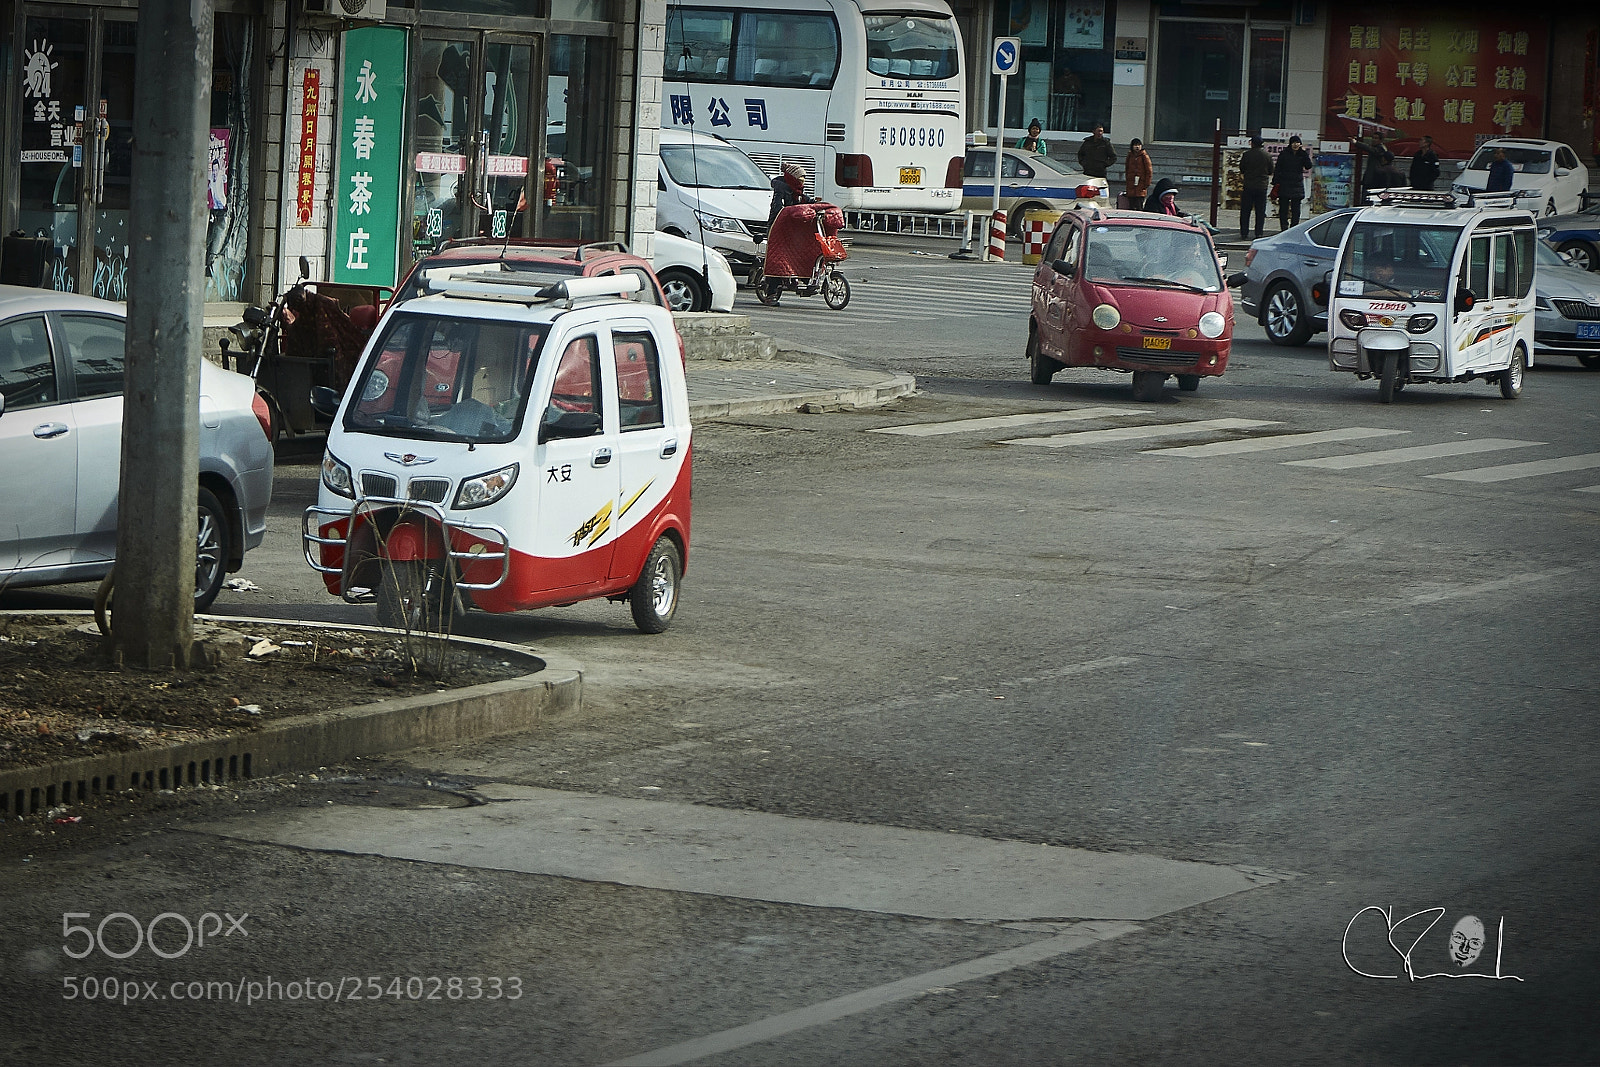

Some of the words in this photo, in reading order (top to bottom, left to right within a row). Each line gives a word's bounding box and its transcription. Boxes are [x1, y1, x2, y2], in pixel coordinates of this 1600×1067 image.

[1350, 24, 1380, 49] 富强
[1399, 27, 1430, 50] 民主
[1448, 30, 1479, 53] 文明
[1497, 31, 1529, 55] 和谐
[1348, 60, 1377, 84] 自由
[1396, 62, 1429, 87] 平等
[1445, 65, 1477, 88] 公正
[1494, 66, 1526, 91] 法治
[33, 100, 61, 122] 全天
[669, 94, 769, 131] 限公司
[1345, 95, 1376, 119] 爱国
[1394, 96, 1426, 121] 敬业
[1443, 98, 1475, 124] 诚信
[1493, 100, 1525, 126] 友善
[50, 123, 76, 147] 营业
[879, 126, 945, 148] 京B08980
[346, 59, 378, 269] 永春茶庄
[547, 463, 572, 484] 大安
